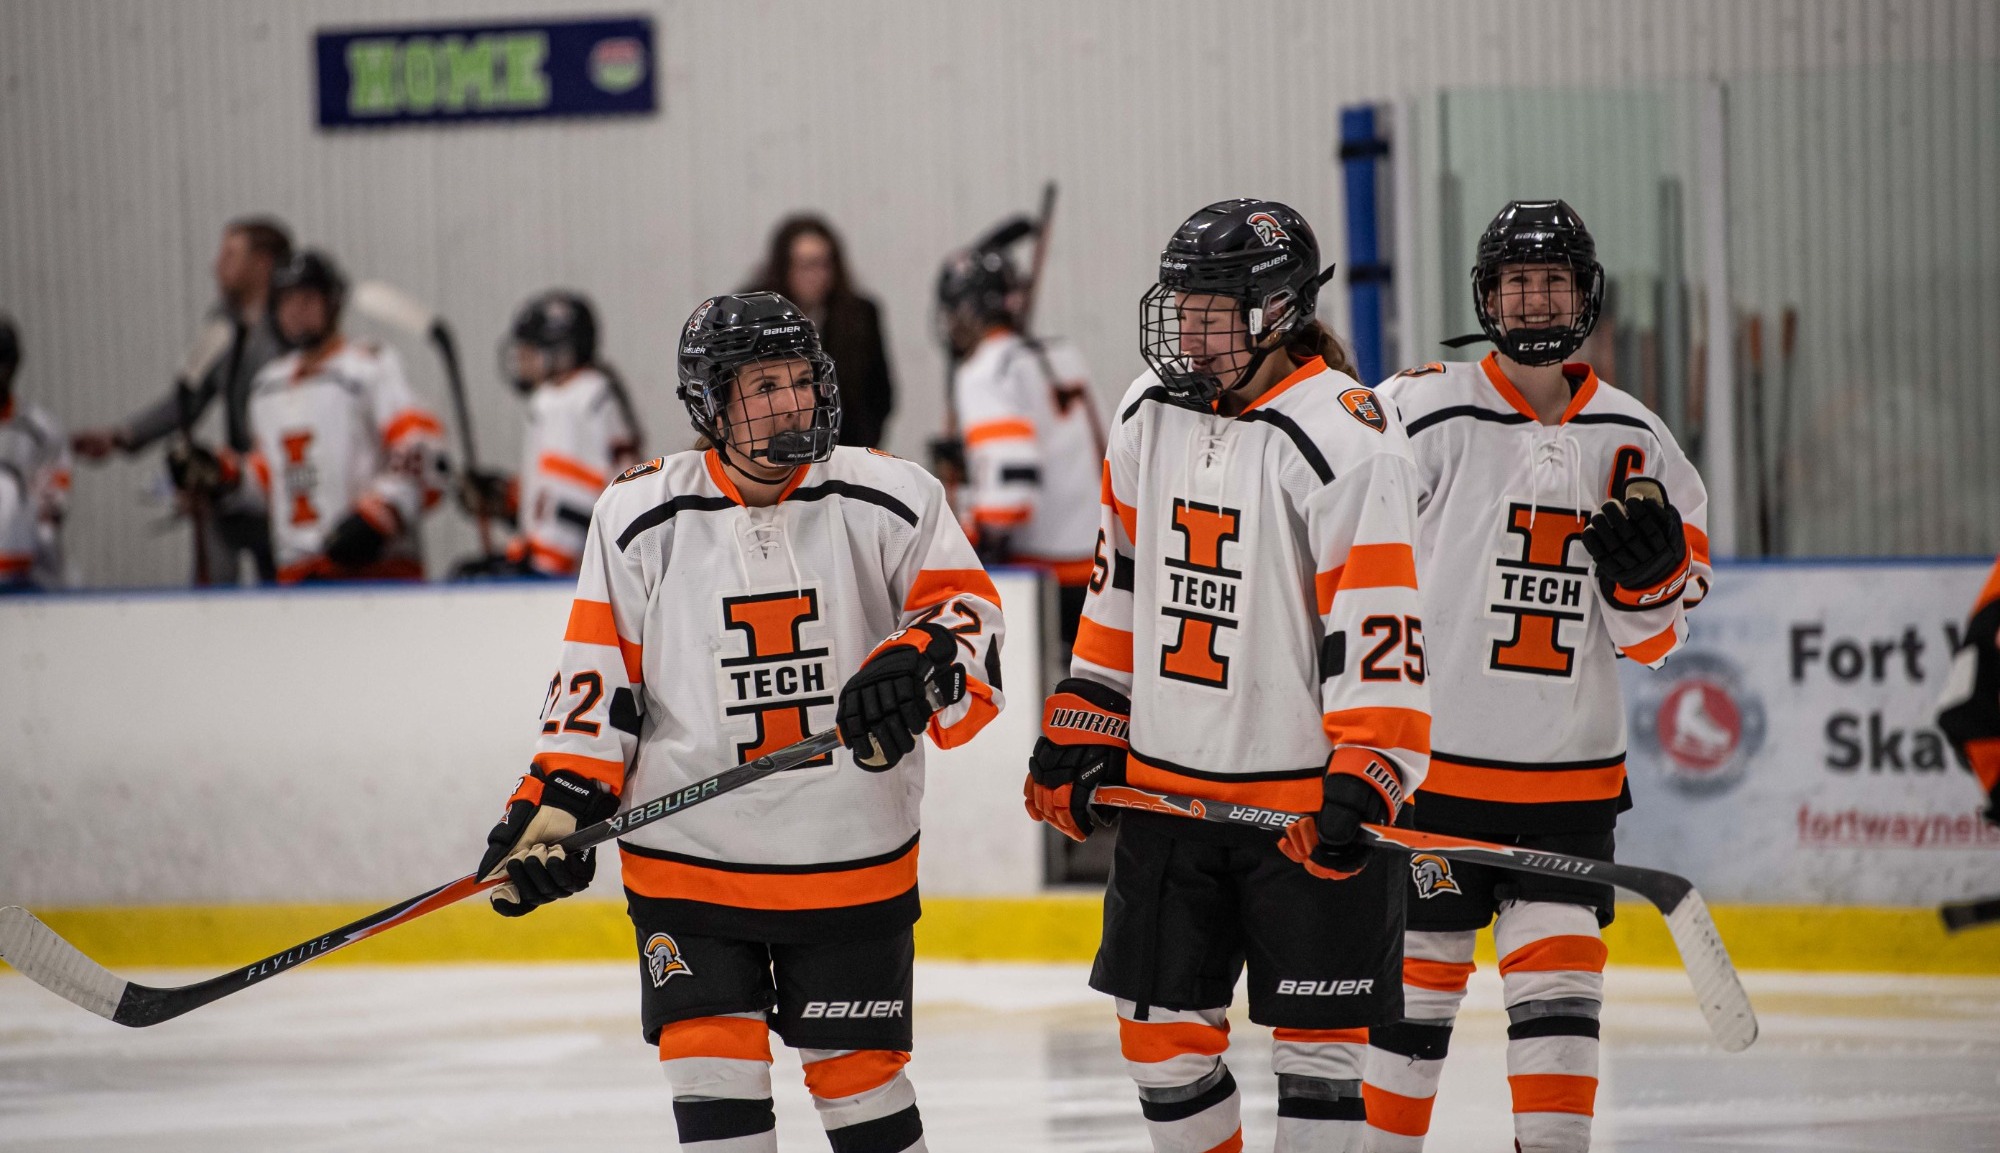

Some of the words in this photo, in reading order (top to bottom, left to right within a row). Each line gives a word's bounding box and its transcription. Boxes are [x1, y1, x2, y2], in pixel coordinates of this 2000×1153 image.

[347, 34, 549, 117] HOME
[1251, 253, 1288, 274] BAUER
[763, 325, 801, 336] BAUER
[1518, 340, 1562, 352] CCM
[1168, 572, 1238, 614] TECH
[1501, 572, 1583, 607] TECH
[1360, 613, 1426, 686] 25
[1790, 622, 1925, 682] Fort
[730, 662, 826, 701] TECH
[1050, 708, 1130, 742] WARRI
[1824, 711, 1946, 773] Ska
[554, 776, 590, 796] BAUER
[1081, 762, 1104, 781] COVERT
[628, 778, 719, 828] BAUER
[1229, 806, 1299, 828] BAUER
[1522, 854, 1595, 875] FLYLITE
[246, 936, 331, 981] FLYLITE
[1276, 978, 1375, 996] BAUER
[800, 1000, 904, 1019] BAUER
